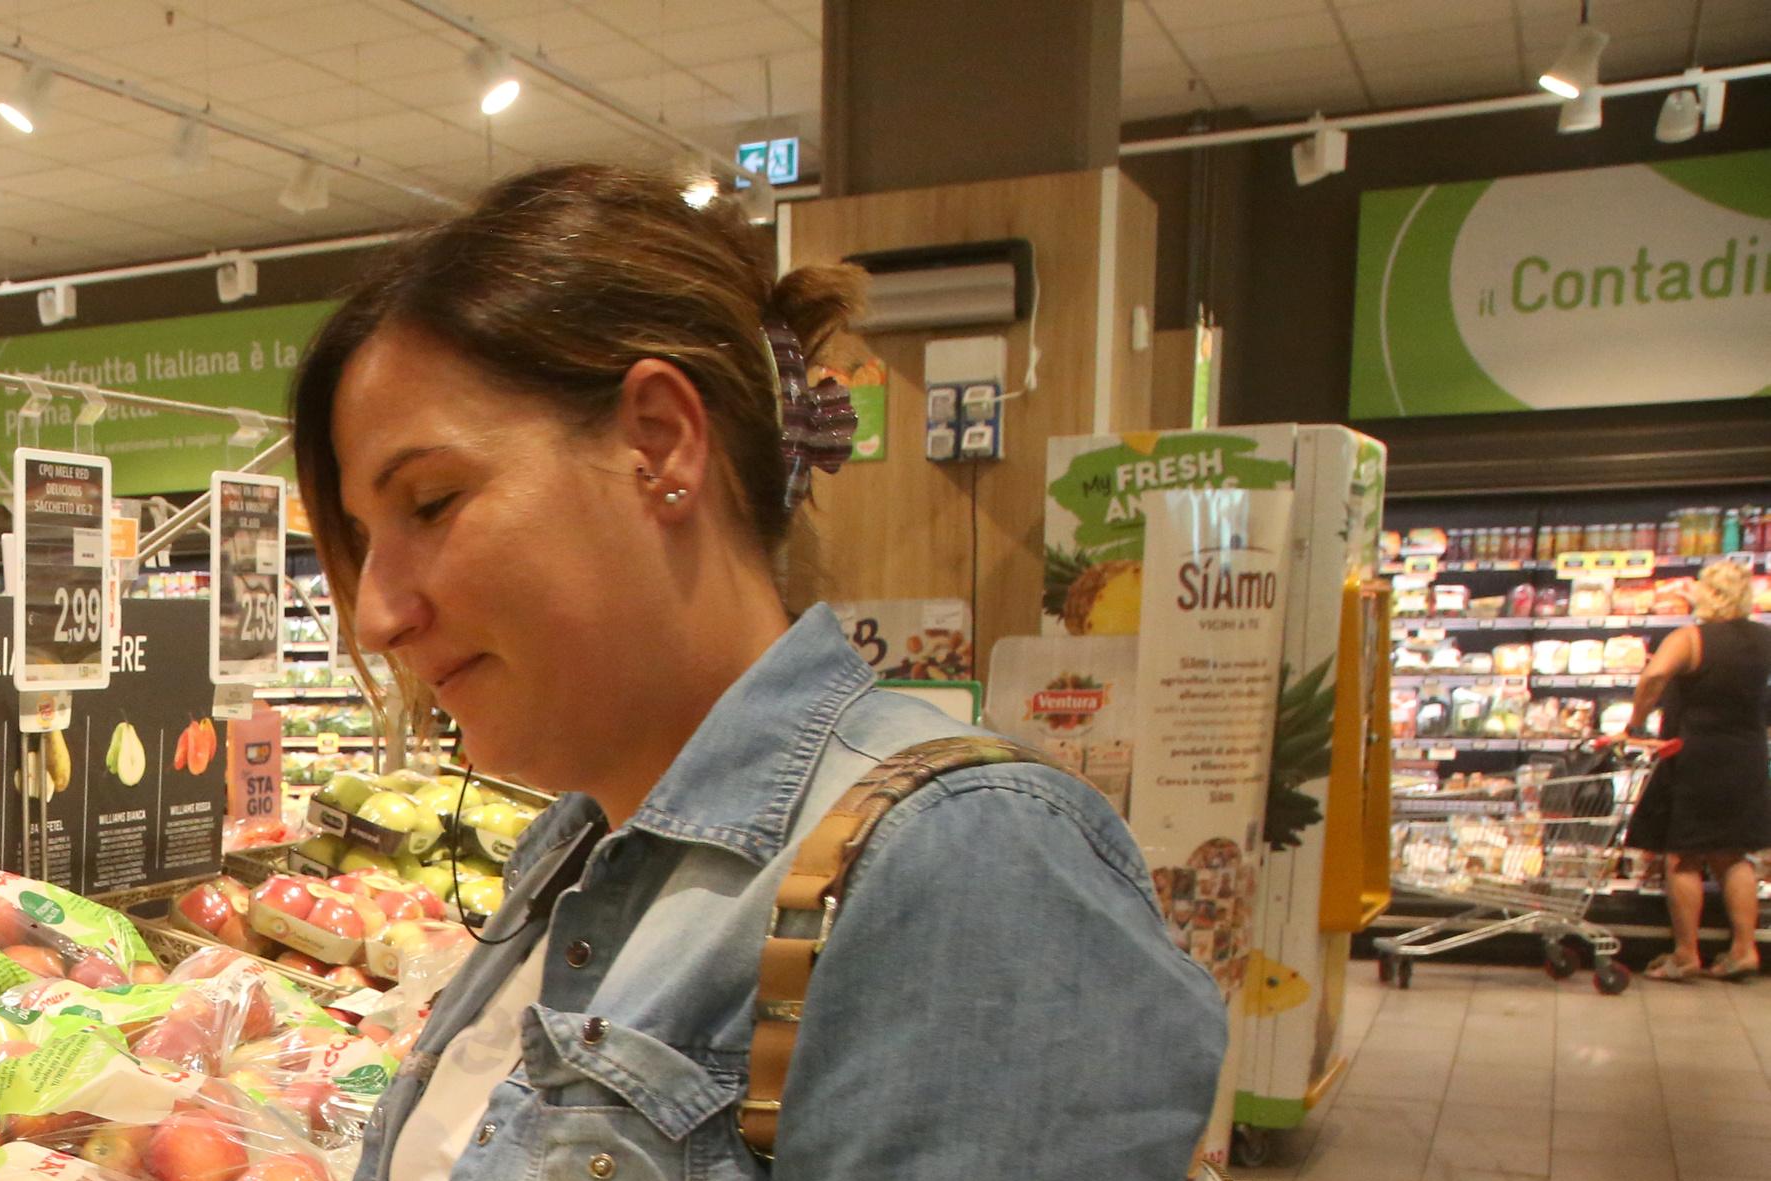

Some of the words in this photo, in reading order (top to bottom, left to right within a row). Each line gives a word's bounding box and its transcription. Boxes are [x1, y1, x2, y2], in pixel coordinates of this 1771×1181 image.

[1478, 289, 1496, 318] il
[145, 350, 241, 382] Italiana
[250, 340, 265, 370] è
[274, 339, 298, 369] la
[1117, 447, 1225, 493] FRESH
[53, 586, 102, 643] 2,99
[246, 775, 274, 796] STA
[246, 797, 274, 816] GIO
